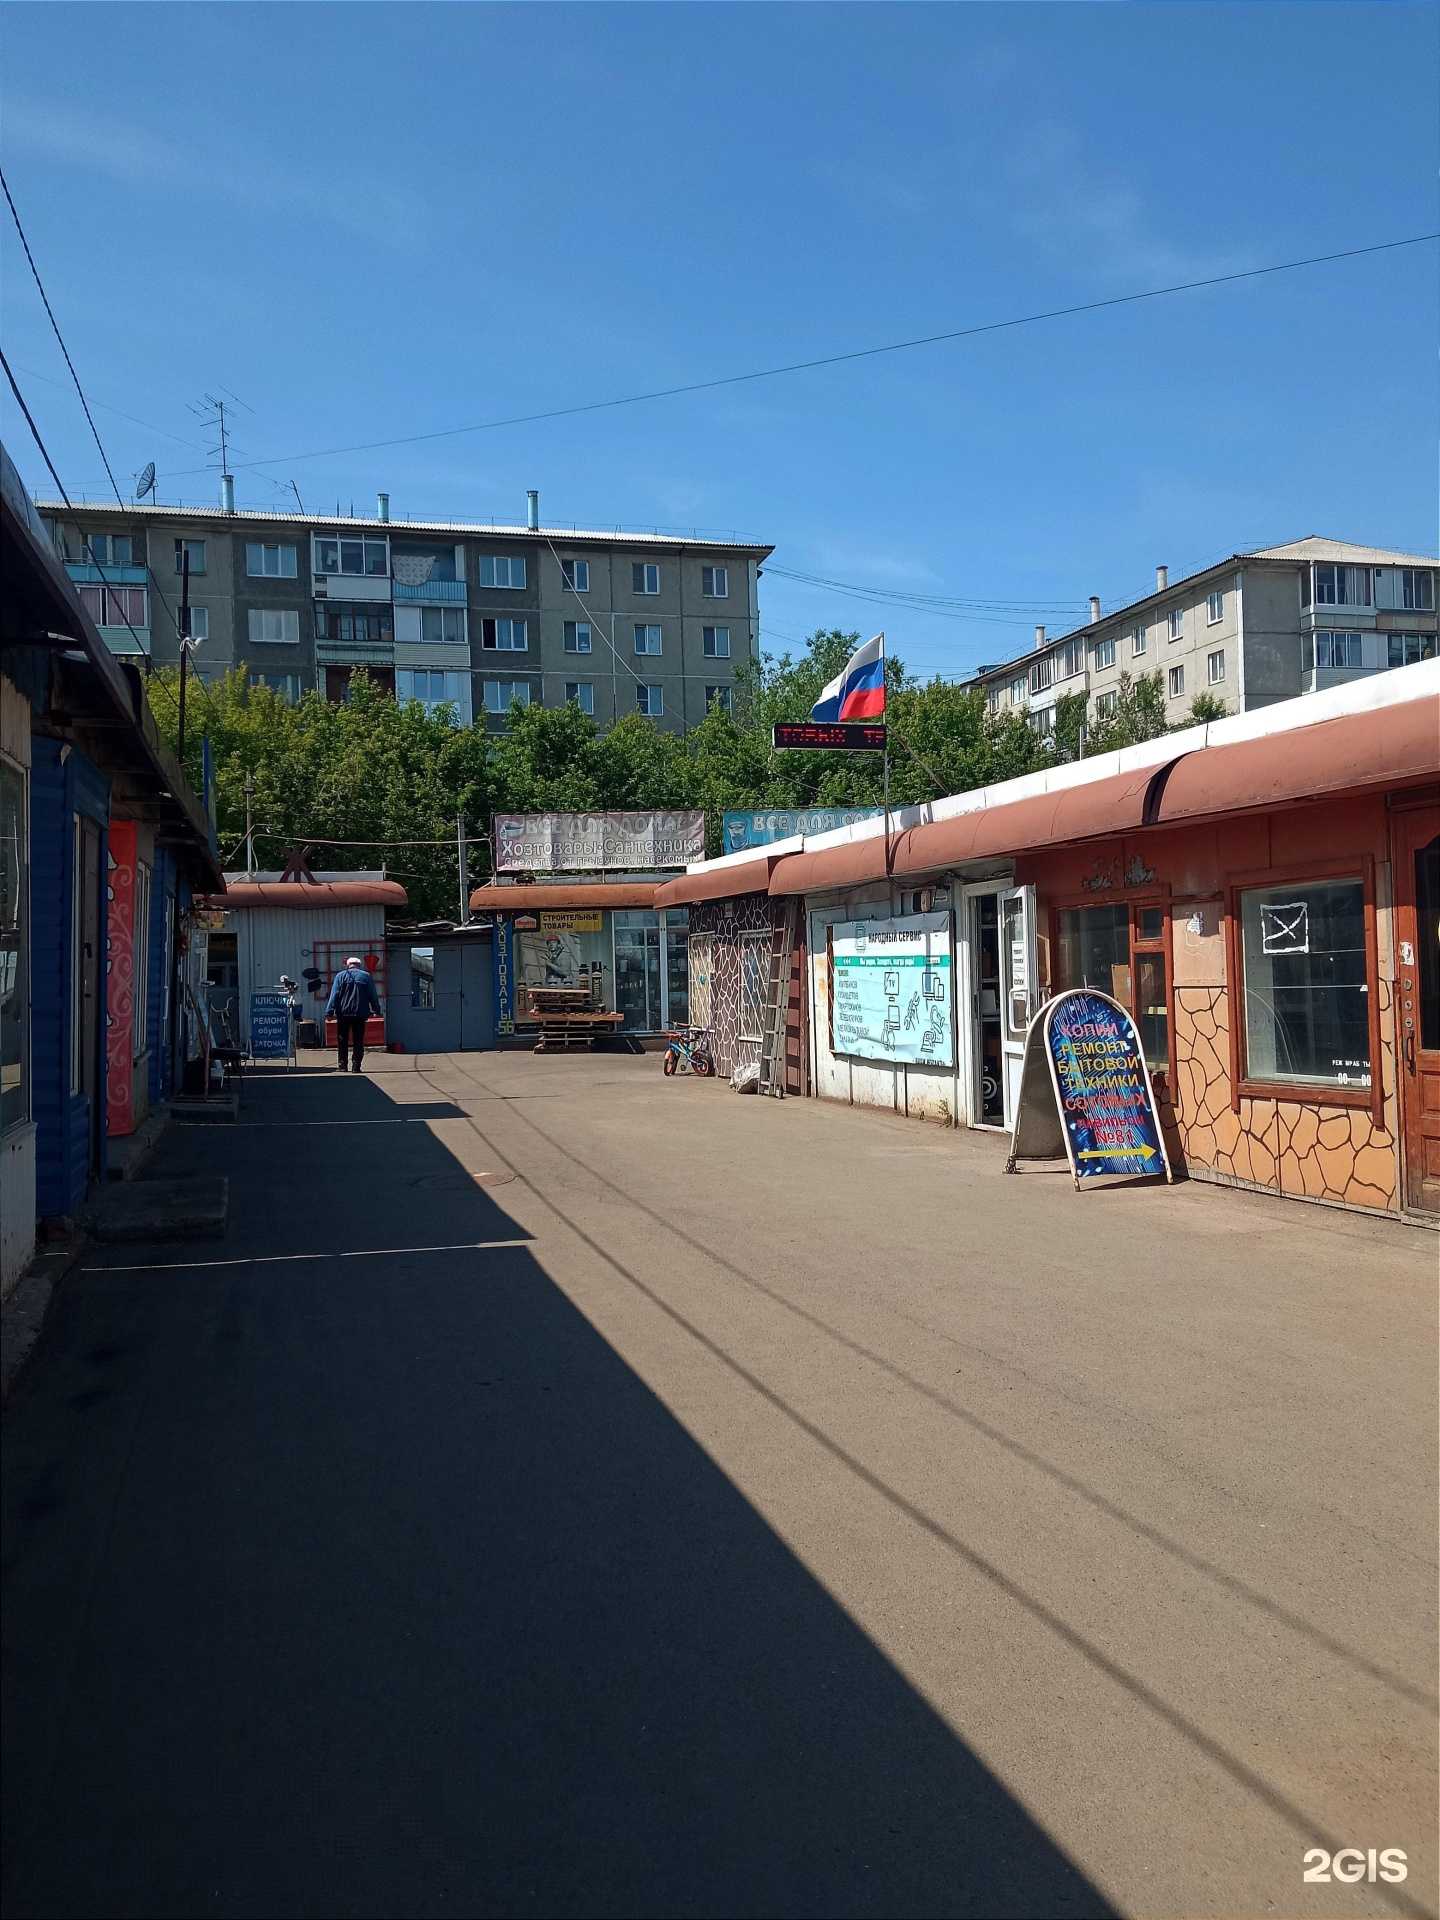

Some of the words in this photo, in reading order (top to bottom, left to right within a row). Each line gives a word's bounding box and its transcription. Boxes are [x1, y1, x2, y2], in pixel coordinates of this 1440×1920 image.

[752, 814, 789, 833] ВСЕ
[794, 813, 835, 834] ДЛЯ
[502, 840, 597, 857] Хозтовары
[603, 837, 702, 855] Сантехника
[504, 857, 557, 869] Средства
[560, 857, 573, 866] от
[542, 913, 599, 921] СТРОИТЕЛЬНЫЕ
[543, 922, 574, 930] ТОВАРЫ
[868, 929, 898, 944] НАРОДНЫЙ
[898, 930, 922, 942] СЕРВИС
[497, 922, 512, 1020] ХОЗТОВАРЫ
[253, 1016, 287, 1025] РЕМОНТ
[1060, 1040, 1127, 1056] РЕМОНТ
[1057, 1053, 1139, 1074] БЫТОВОЙ
[1066, 1074, 1140, 1089] ТЕХНИКИ
[1094, 1129, 1134, 1144] №81
